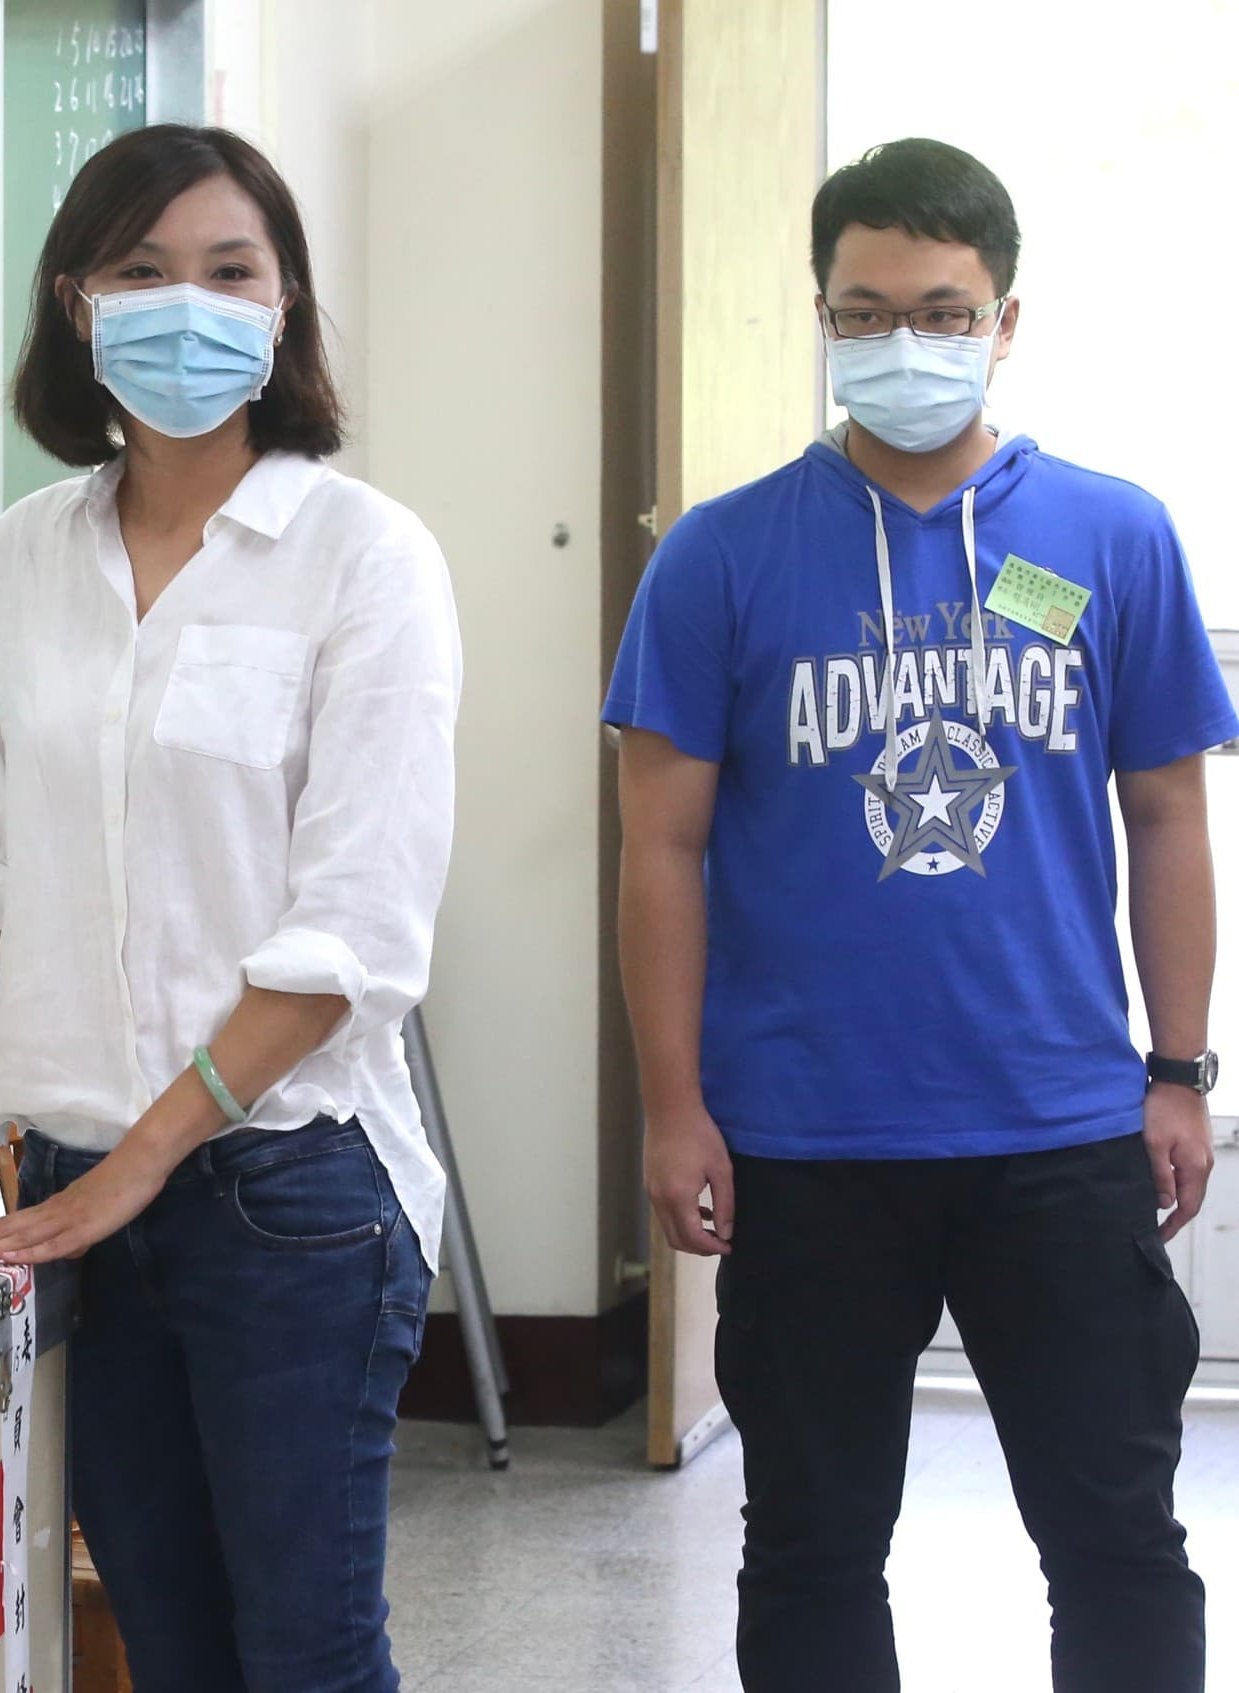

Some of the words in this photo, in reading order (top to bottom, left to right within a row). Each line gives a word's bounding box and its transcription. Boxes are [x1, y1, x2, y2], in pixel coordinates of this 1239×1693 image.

[70, 76, 80, 112] 6
[858, 610, 930, 647] New
[936, 601, 1015, 641] York
[788, 644, 1083, 765] ADVANTAGE
[877, 727, 921, 772] DAM
[947, 725, 994, 769] CLASSIC
[867, 796, 892, 847] SPIRIT
